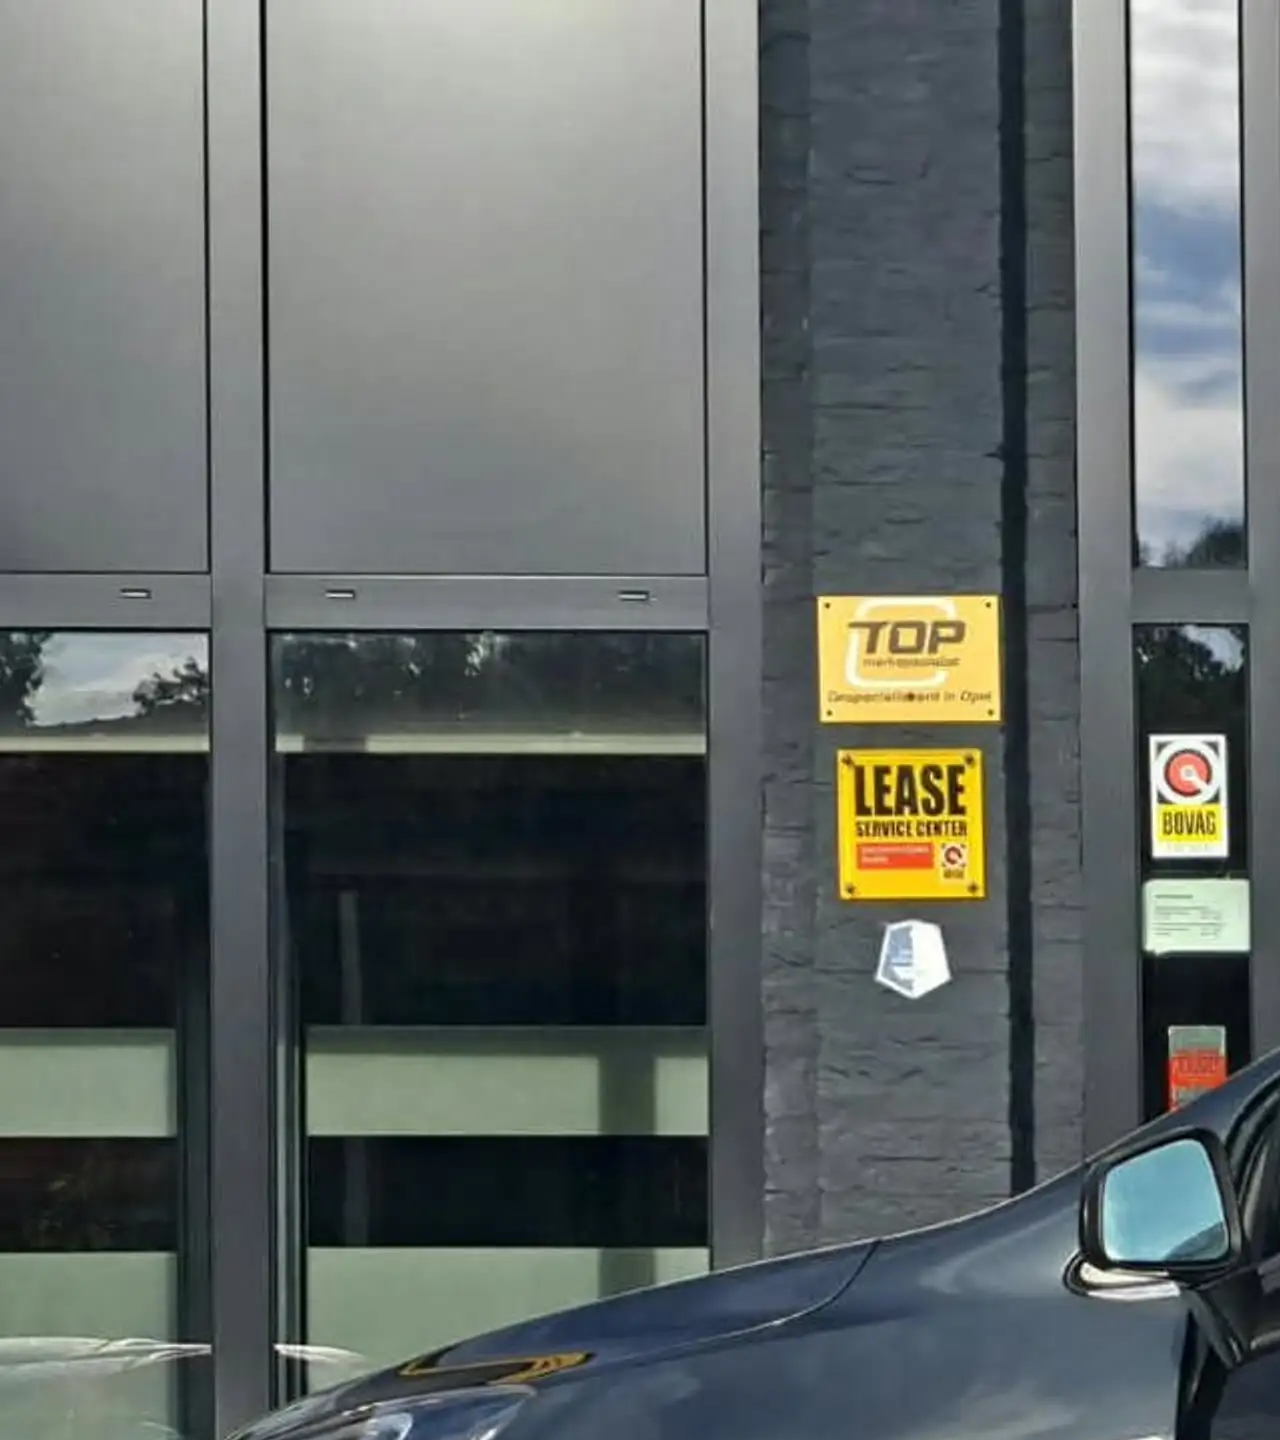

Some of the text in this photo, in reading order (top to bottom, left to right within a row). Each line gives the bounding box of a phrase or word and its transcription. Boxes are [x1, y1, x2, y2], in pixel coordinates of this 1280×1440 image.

[848, 619, 967, 655] TOP
[854, 763, 967, 817] LEASE
[856, 819, 968, 838] SERVICE CENTER
[1161, 809, 1218, 836] BOVAG
